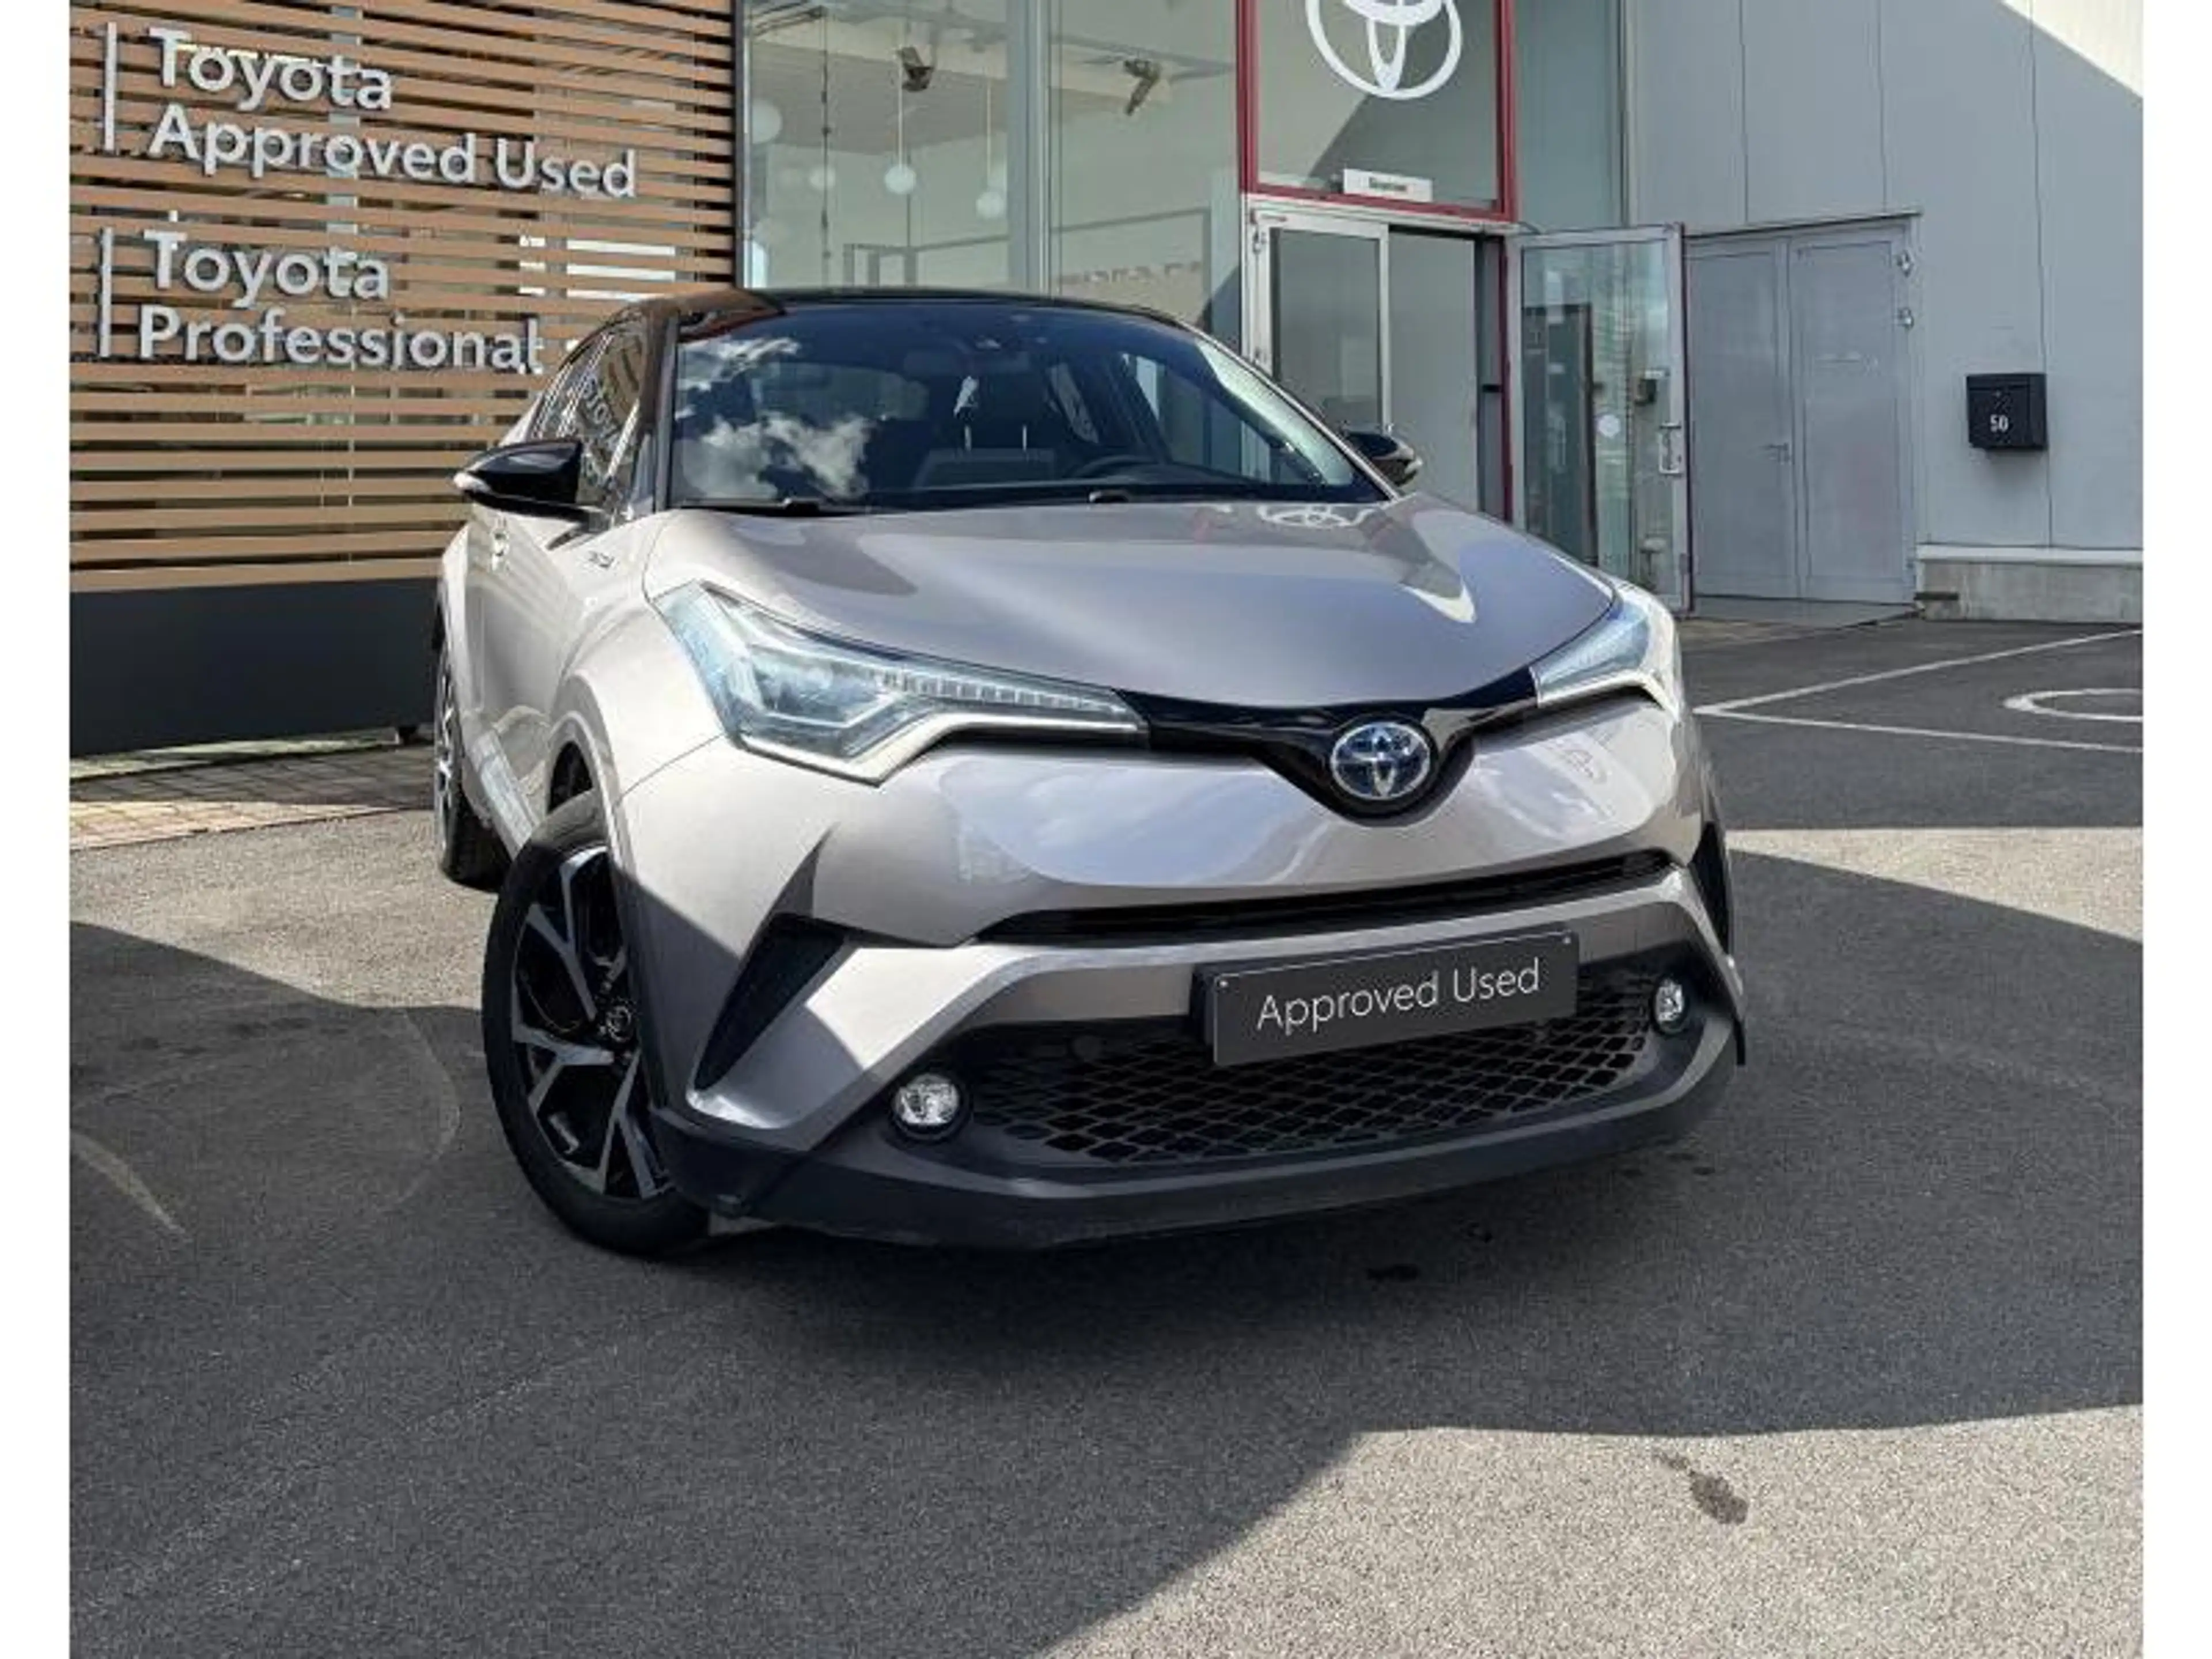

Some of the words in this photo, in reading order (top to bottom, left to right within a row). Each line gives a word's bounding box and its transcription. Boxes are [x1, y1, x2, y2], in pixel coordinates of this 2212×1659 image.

[149, 27, 393, 111] Toyota
[147, 103, 479, 183] Approved
[497, 137, 637, 198] Used
[143, 229, 389, 308] Toyota
[139, 304, 541, 373] Professional
[1990, 414, 2009, 432] 50
[1257, 970, 1440, 1036] Approved
[1452, 956, 1540, 1003] Used
